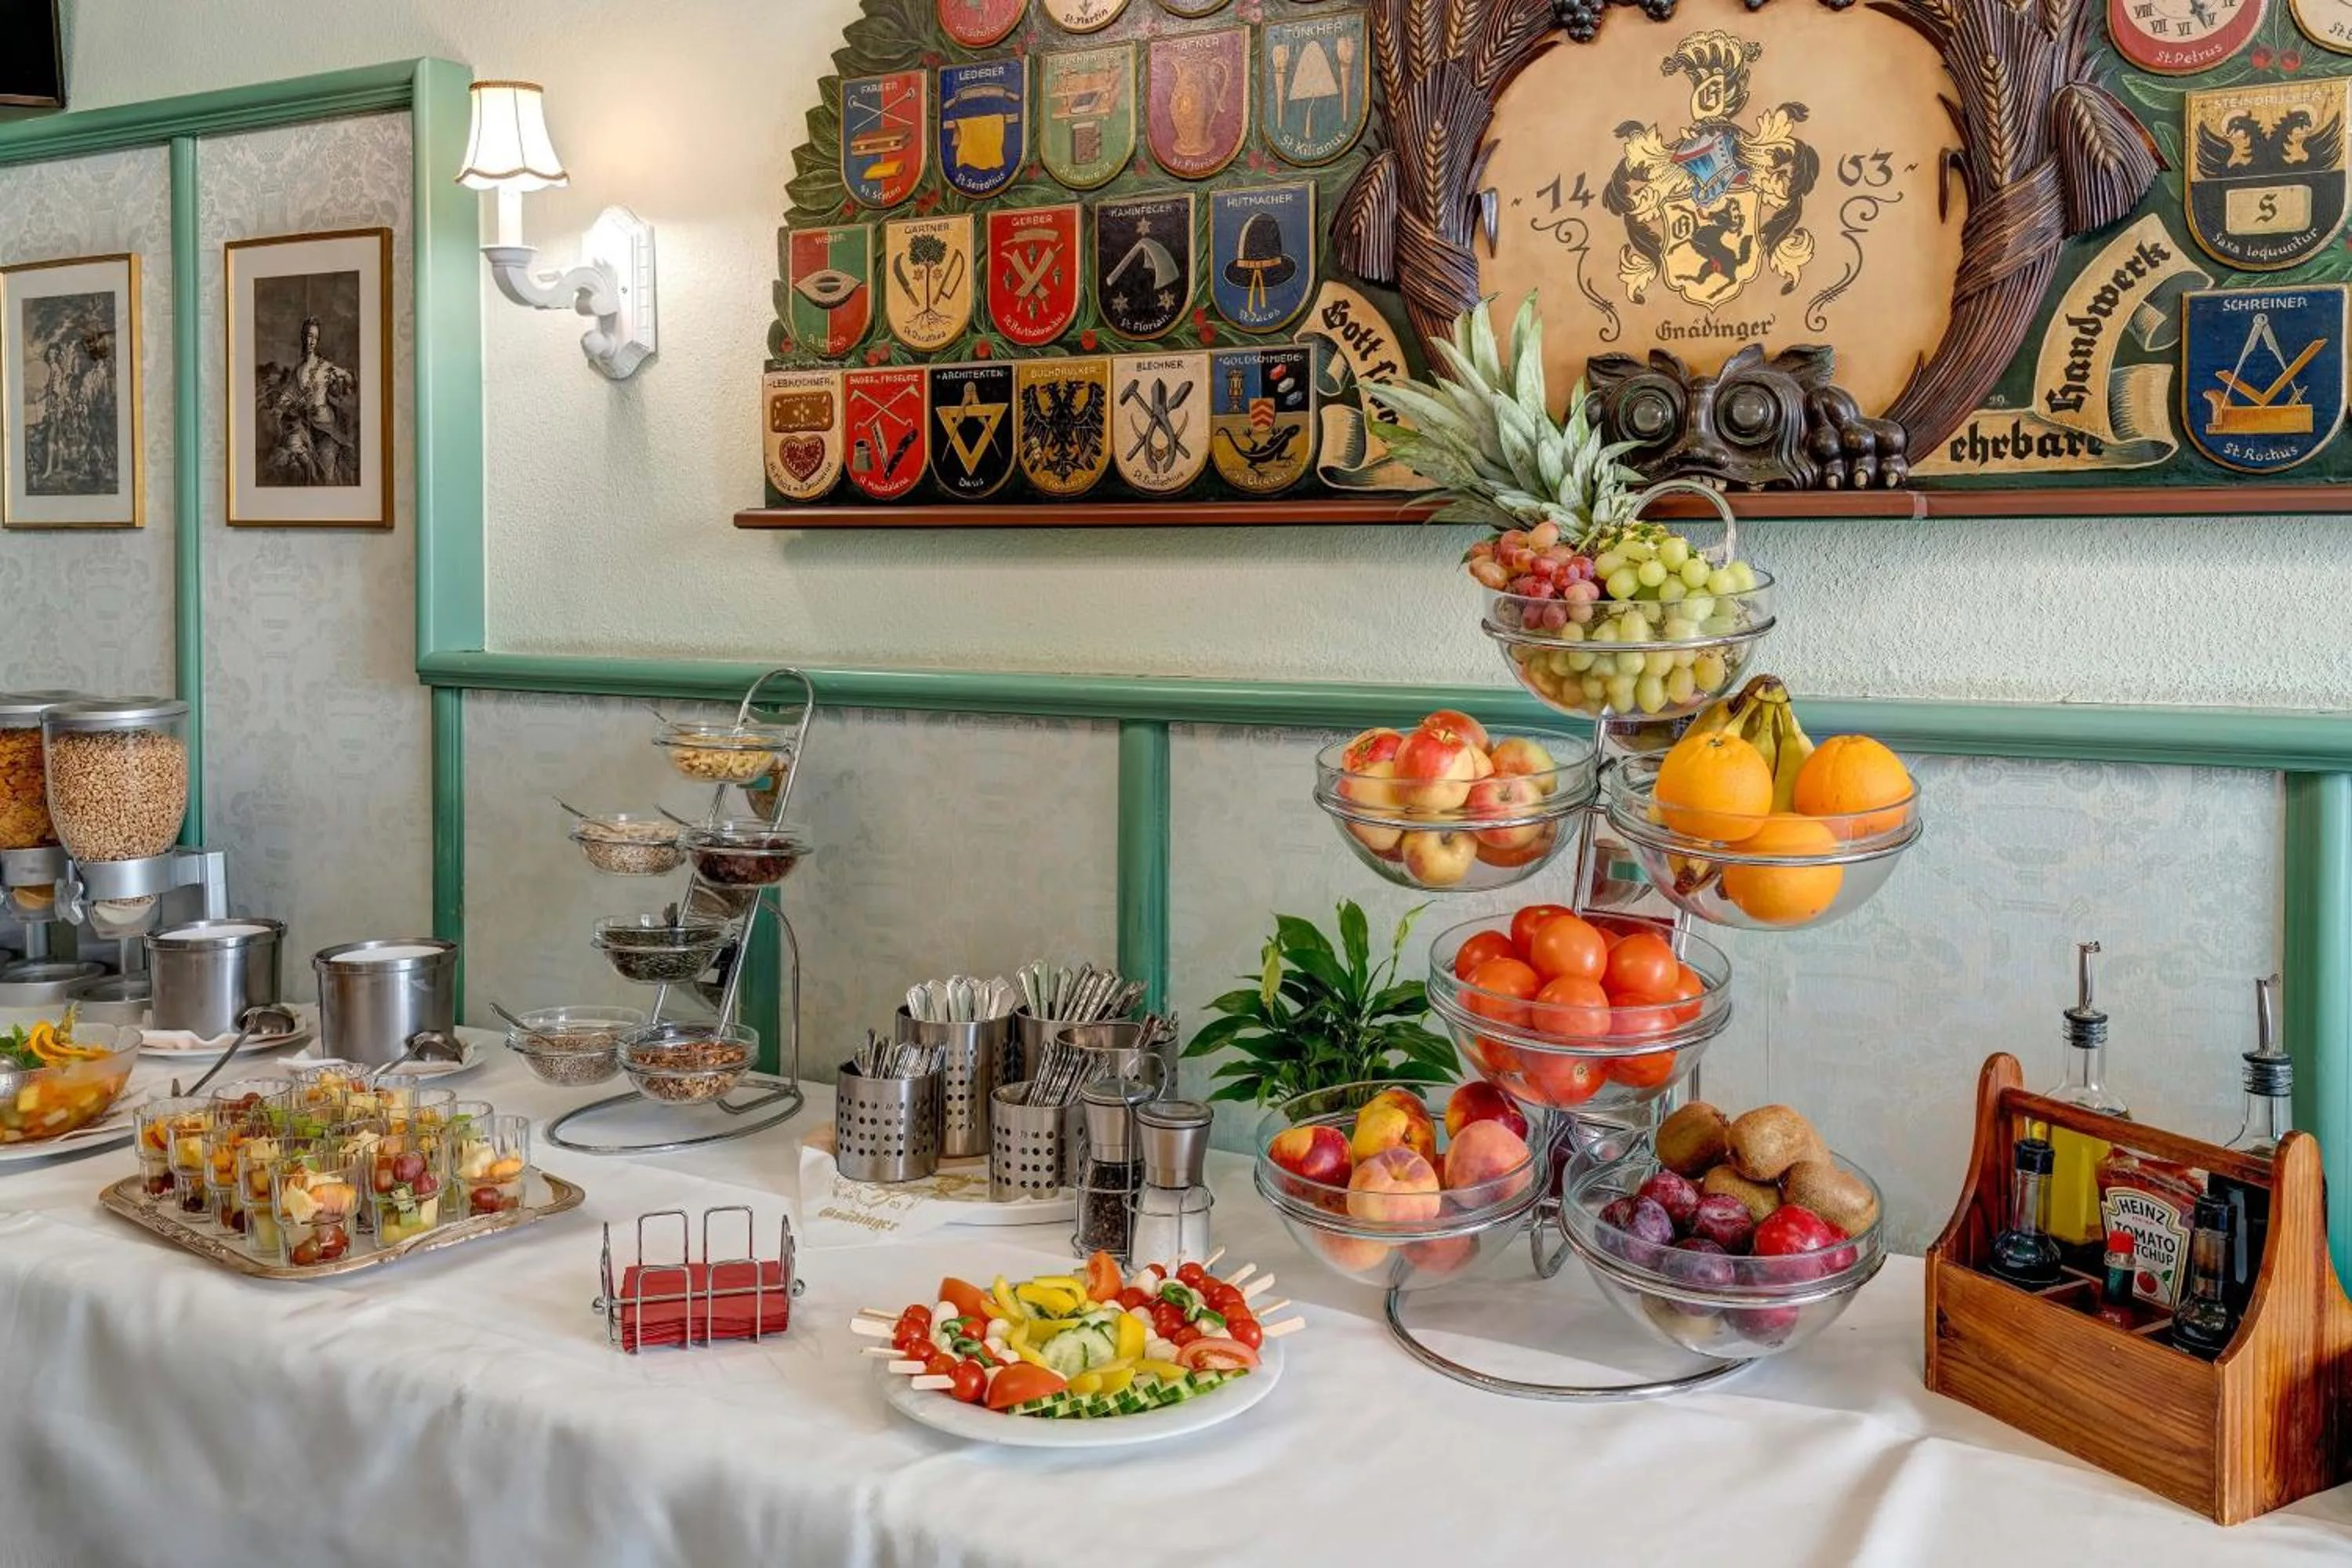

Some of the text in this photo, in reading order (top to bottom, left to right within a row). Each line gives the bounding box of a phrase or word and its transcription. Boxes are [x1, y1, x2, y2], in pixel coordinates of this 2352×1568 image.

[2133, 4, 2153, 19] VIII
[2151, 19, 2169, 34] VII
[2176, 22, 2192, 36] VI
[959, 66, 1005, 81] LEDERER
[1011, 214, 1054, 227] GERBER
[2222, 296, 2308, 312] SCHREINER
[2044, 238, 2172, 415] Handwerk
[942, 370, 1004, 381] ARCHITEKTEN
[1949, 420, 2105, 465] ehrbare
[2118, 1198, 2166, 1225] HEINZ
[2133, 1243, 2174, 1266] TCHUP
